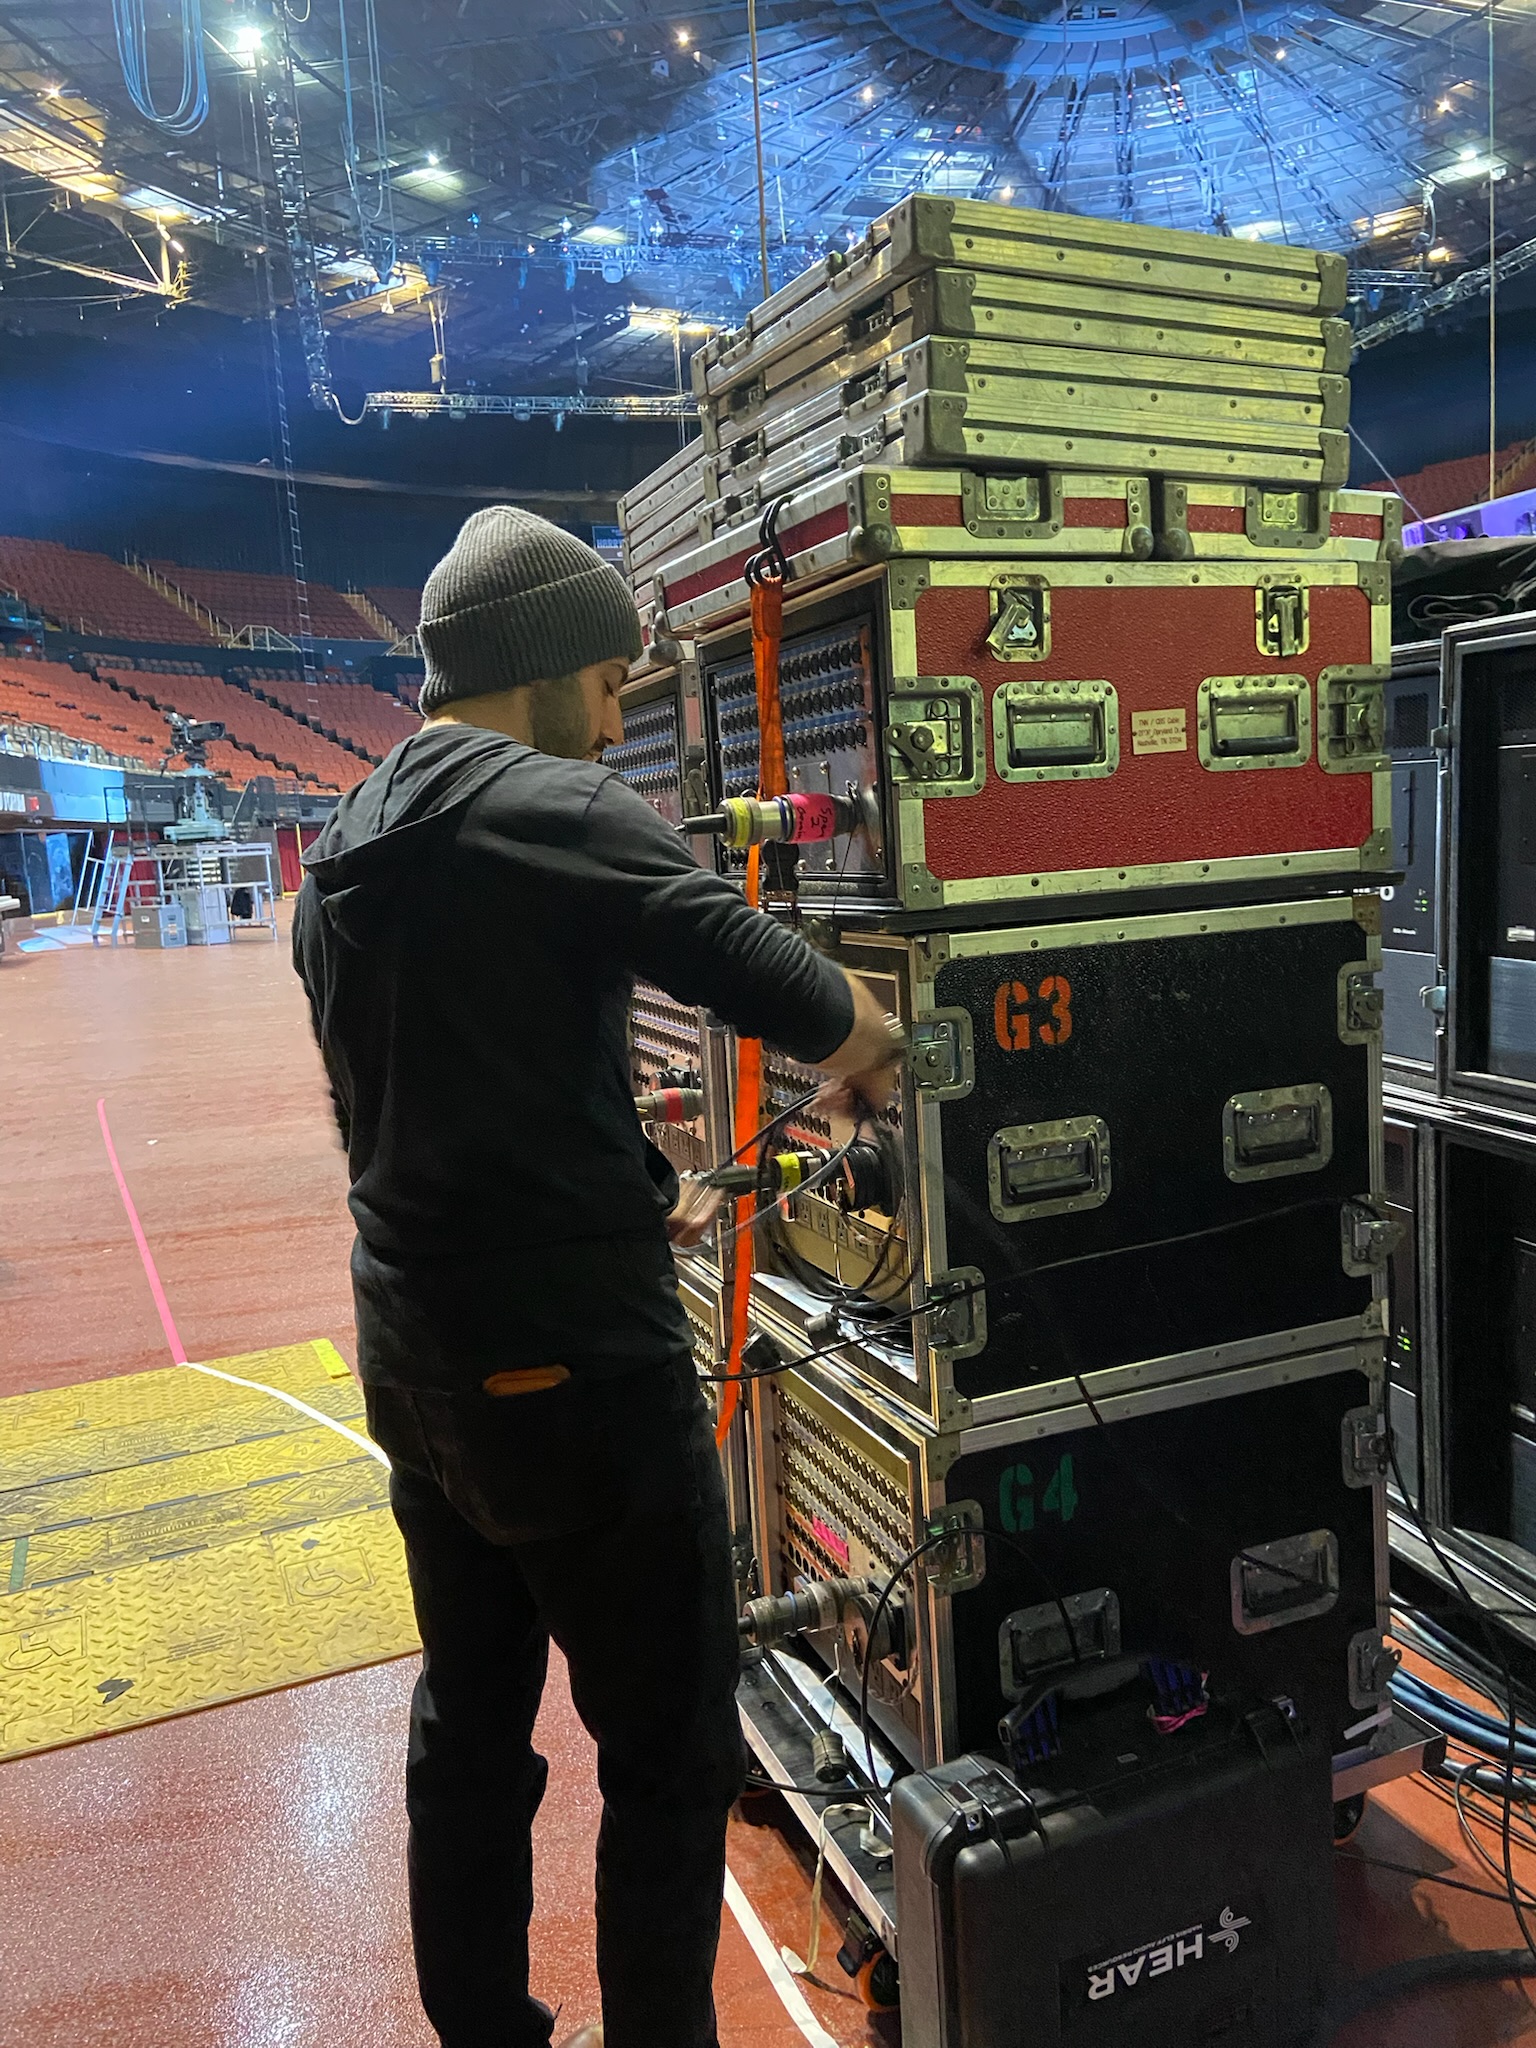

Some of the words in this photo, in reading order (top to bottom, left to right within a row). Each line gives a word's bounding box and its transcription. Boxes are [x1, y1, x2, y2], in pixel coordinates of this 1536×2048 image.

[994, 975, 1073, 1052] G3
[998, 1453, 1079, 1534] G4
[1087, 1932, 1203, 2001] HEAR
[1132, 1941, 1157, 1955] AUDIO
